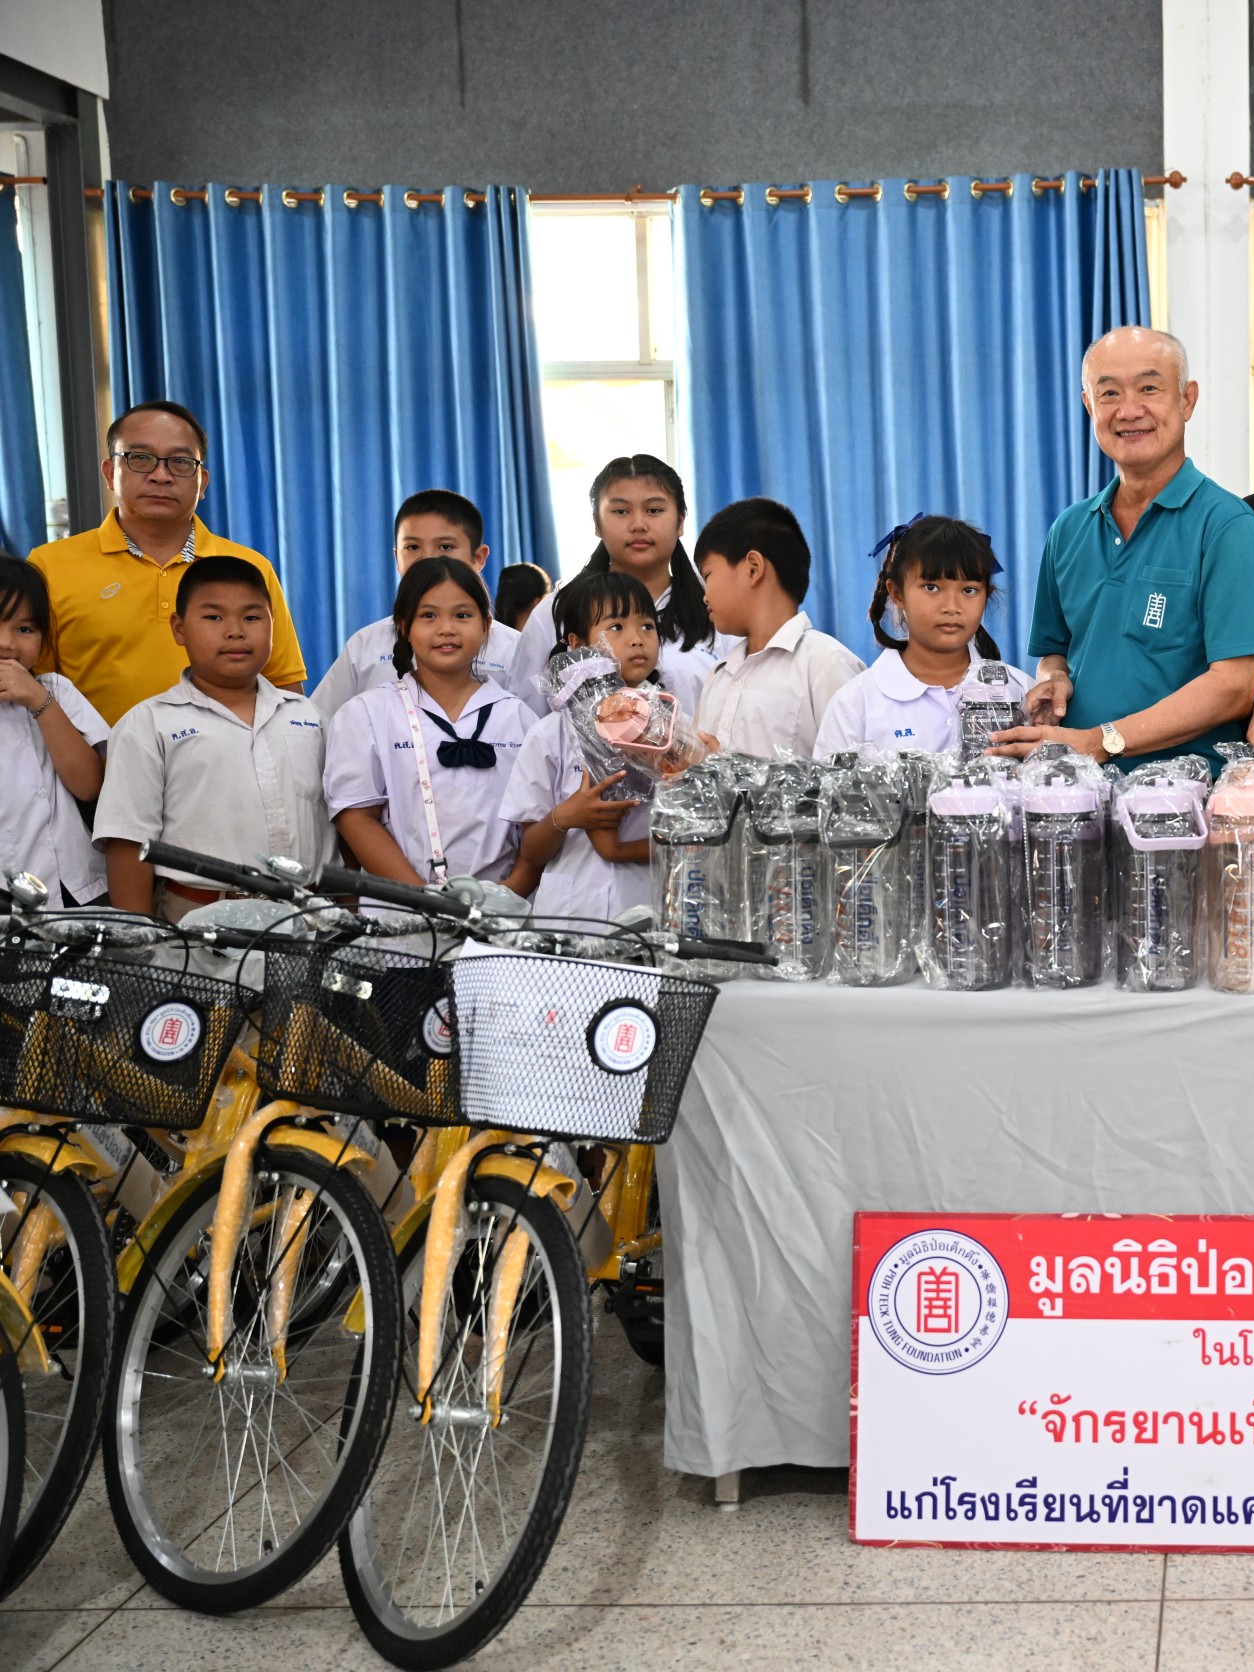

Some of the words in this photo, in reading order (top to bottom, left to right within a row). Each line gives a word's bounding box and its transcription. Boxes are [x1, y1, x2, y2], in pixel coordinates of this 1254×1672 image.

[881, 1268, 898, 1291] POH
[879, 1293, 891, 1318] TECK
[883, 1320, 904, 1347] TUNG
[901, 1342, 964, 1363] FOUNDATION
